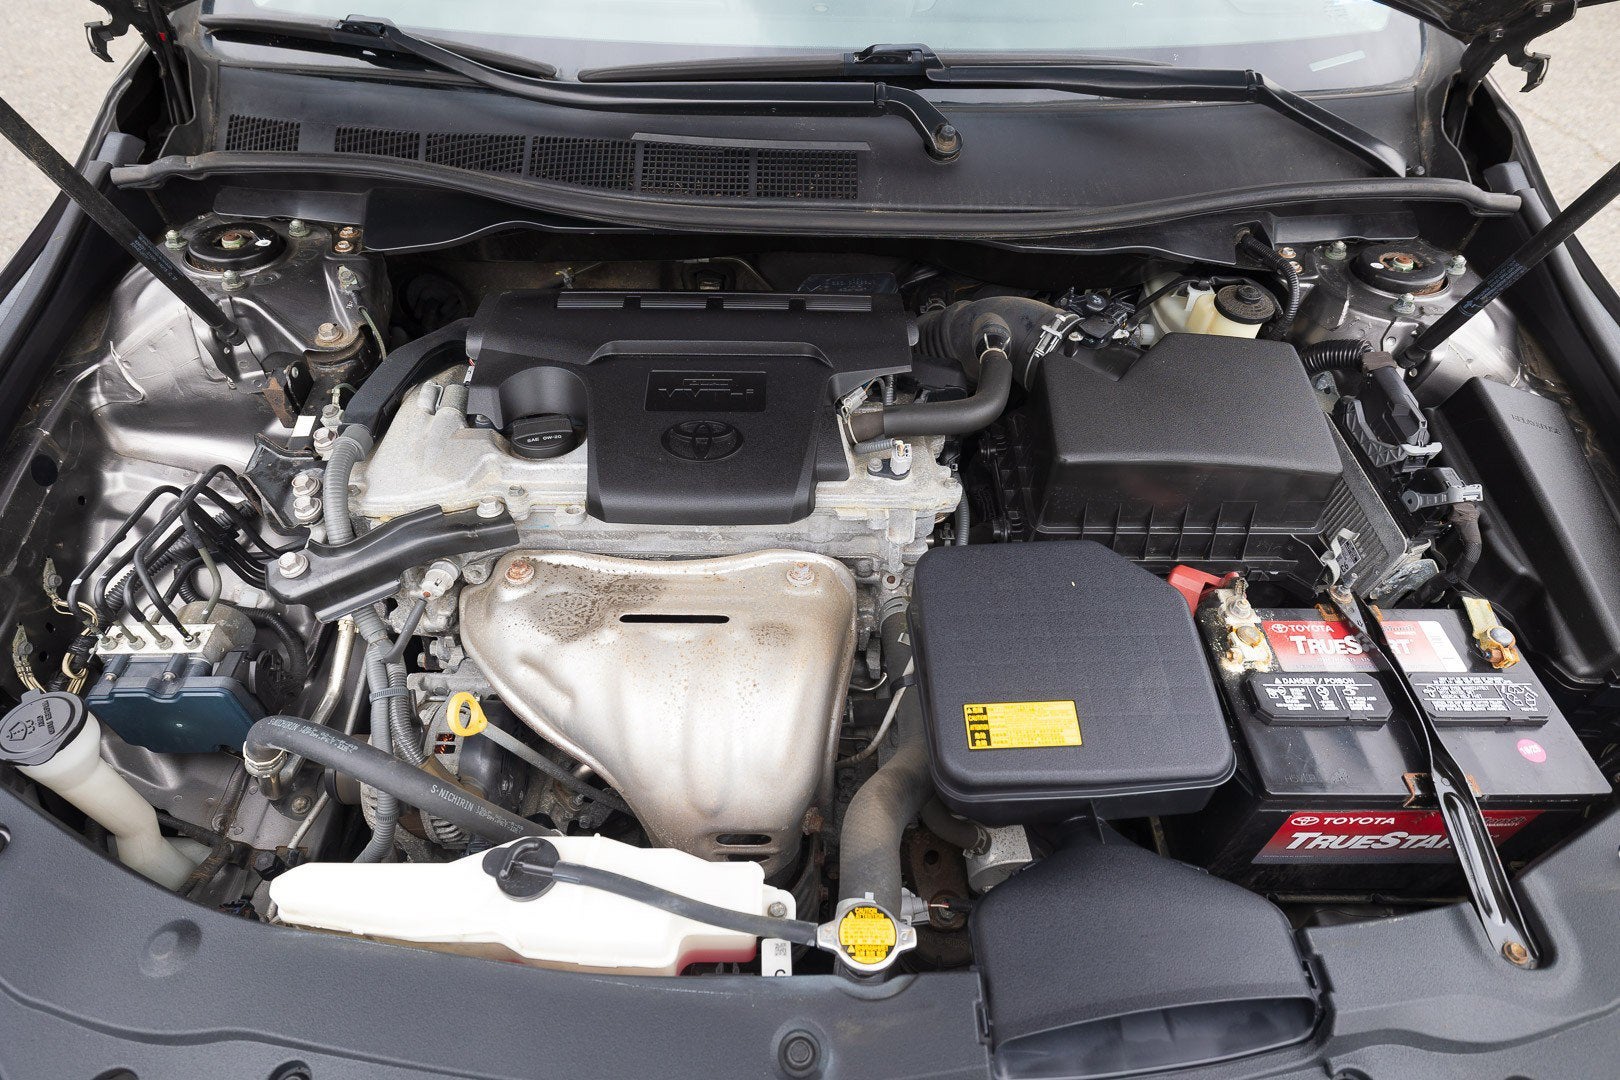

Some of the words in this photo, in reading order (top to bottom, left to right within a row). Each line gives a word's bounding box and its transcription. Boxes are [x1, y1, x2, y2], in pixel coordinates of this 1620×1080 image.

[1288, 624, 1335, 633] TOYOTA
[1289, 635, 1412, 655] TRUESRT
[1282, 677, 1316, 685] DANGER
[1324, 677, 1356, 685] POISON
[1323, 816, 1396, 826] TOYOTA
[1285, 831, 1452, 850] TRUESTA
